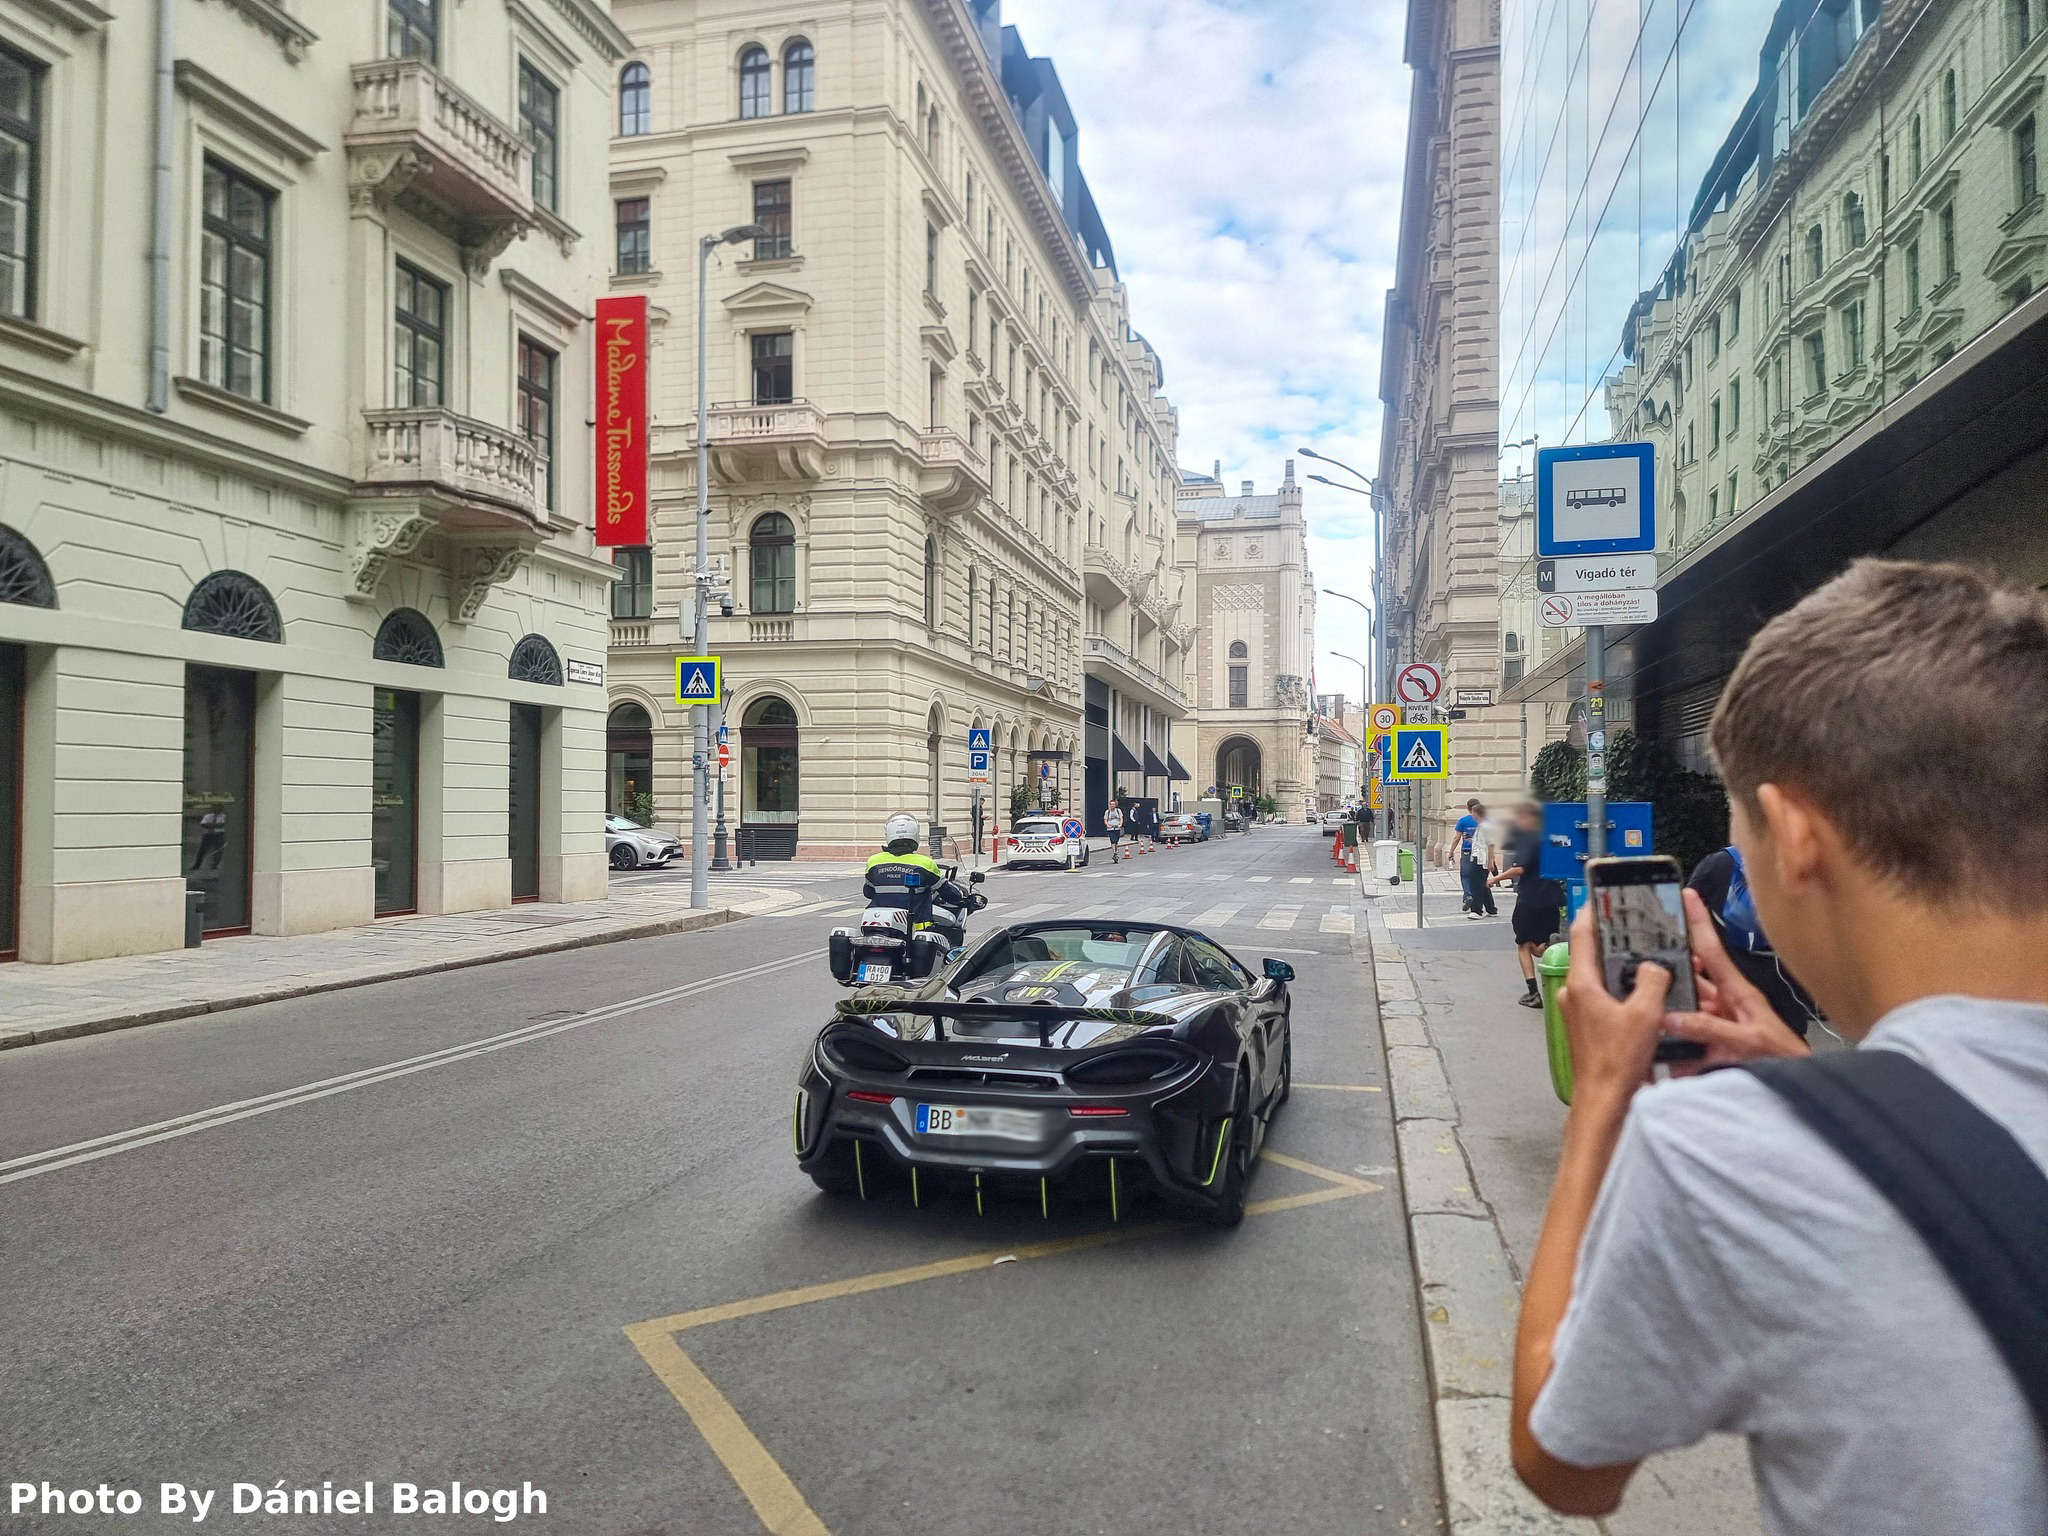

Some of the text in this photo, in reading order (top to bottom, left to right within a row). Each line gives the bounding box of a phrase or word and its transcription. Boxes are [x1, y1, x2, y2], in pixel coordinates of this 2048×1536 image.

[606, 318, 637, 525] Madame Tussauds
[1540, 571, 1552, 582] M
[1575, 566, 1637, 582] Vigadó tér
[1584, 593, 1626, 601] megállóban
[1600, 598, 1640, 606] dohányzás!
[1407, 704, 1430, 712] KIVÉVE
[1380, 715, 1391, 723] 30
[973, 755, 984, 767] P
[870, 973, 884, 982] 012
[960, 1054, 1005, 1062] McLaren
[929, 1109, 952, 1130] BB
